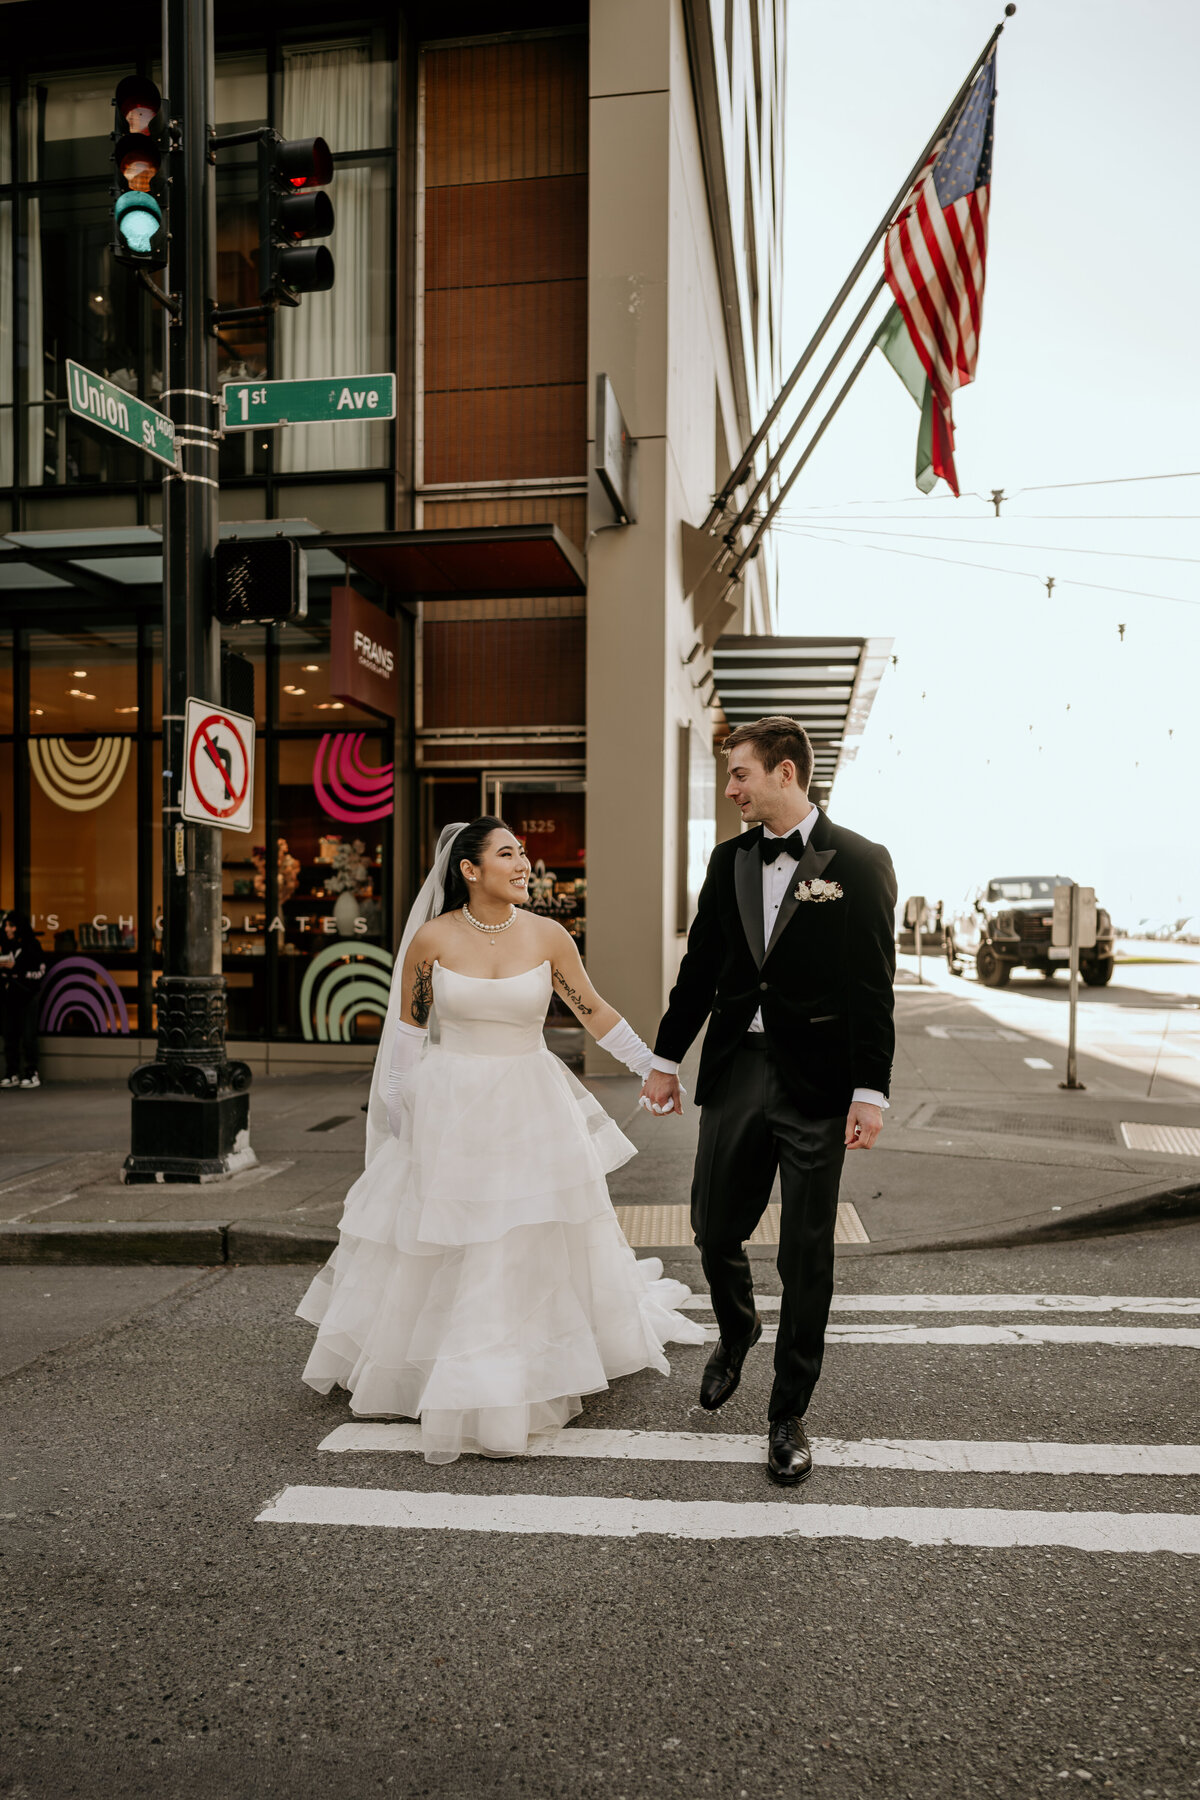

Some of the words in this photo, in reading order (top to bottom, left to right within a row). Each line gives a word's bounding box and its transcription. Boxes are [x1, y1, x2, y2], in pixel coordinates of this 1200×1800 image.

[74, 369, 129, 432] Union
[142, 419, 157, 448] St
[155, 416, 174, 440] 1400
[237, 387, 267, 421] 1st
[336, 387, 379, 411] Ave
[354, 630, 394, 672] FRANS
[522, 820, 556, 833] 1325
[92, 914, 368, 934] CHOLATES
